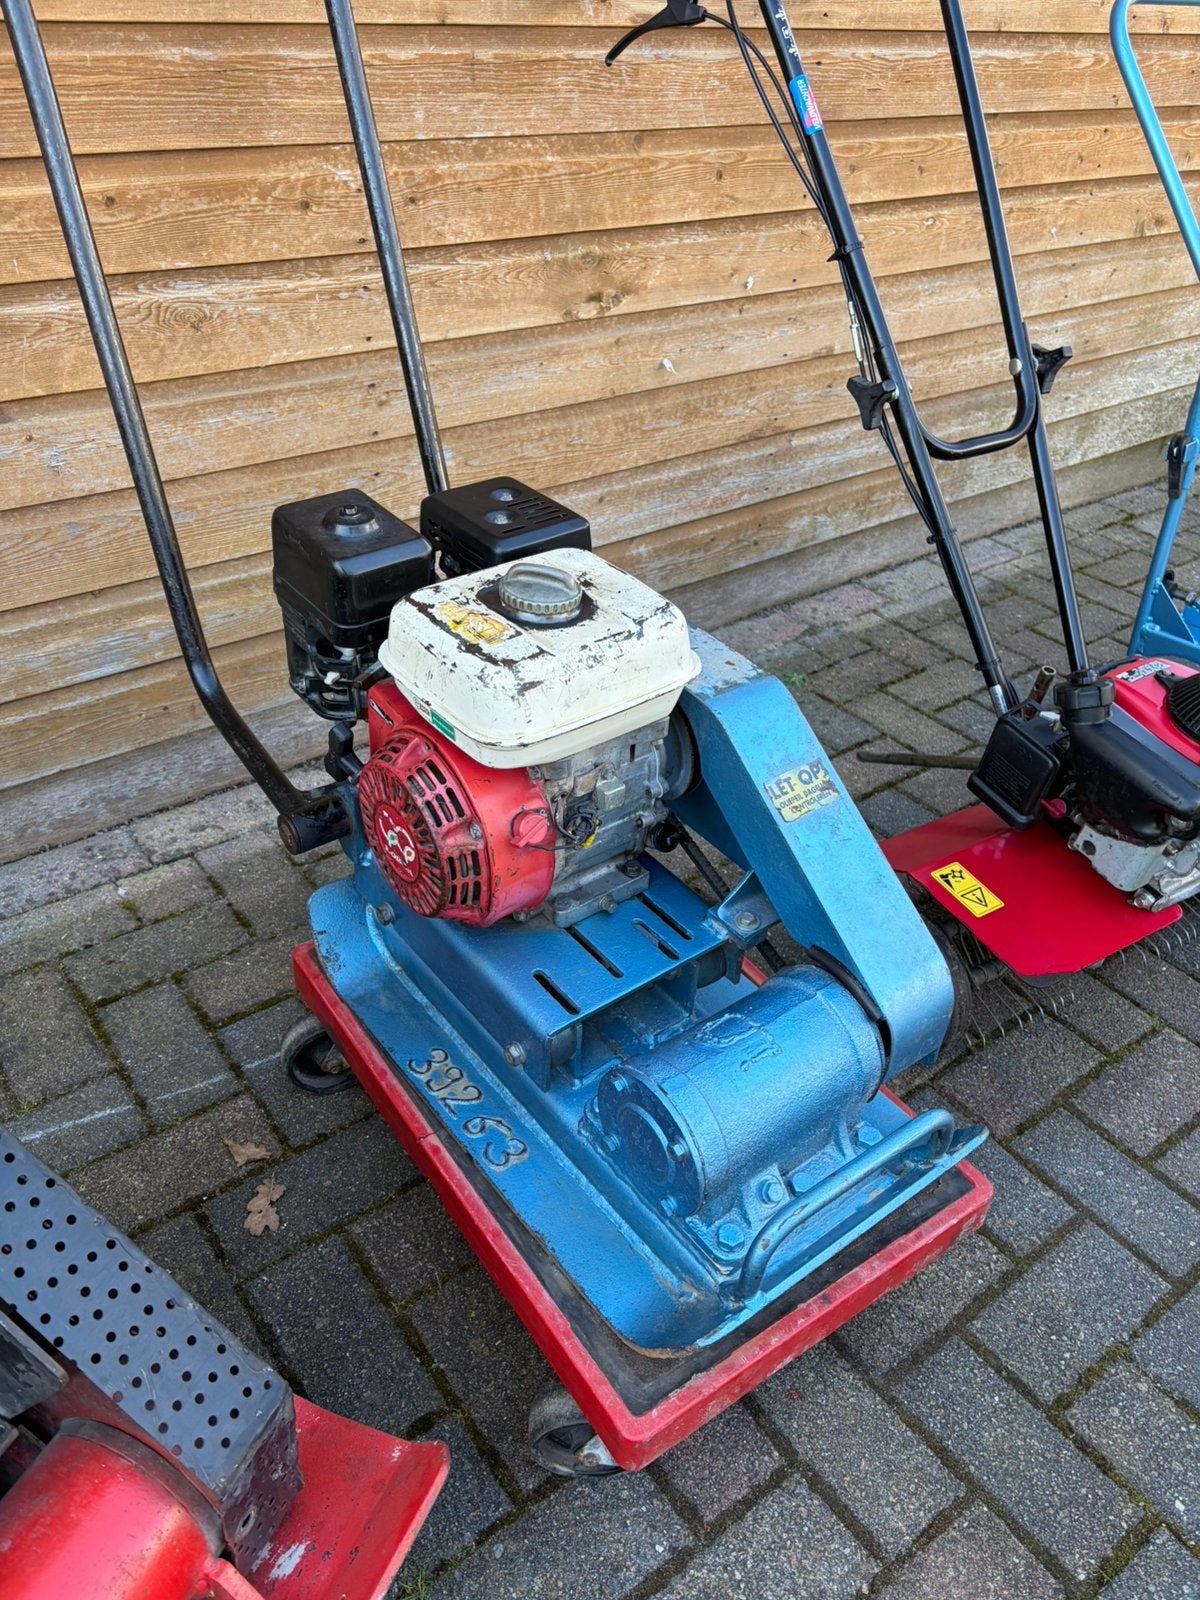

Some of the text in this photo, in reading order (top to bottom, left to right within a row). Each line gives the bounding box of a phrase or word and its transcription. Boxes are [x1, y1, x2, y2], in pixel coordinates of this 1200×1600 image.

[796, 79, 822, 130] VELDWACHTER
[768, 761, 821, 800] LET OP
